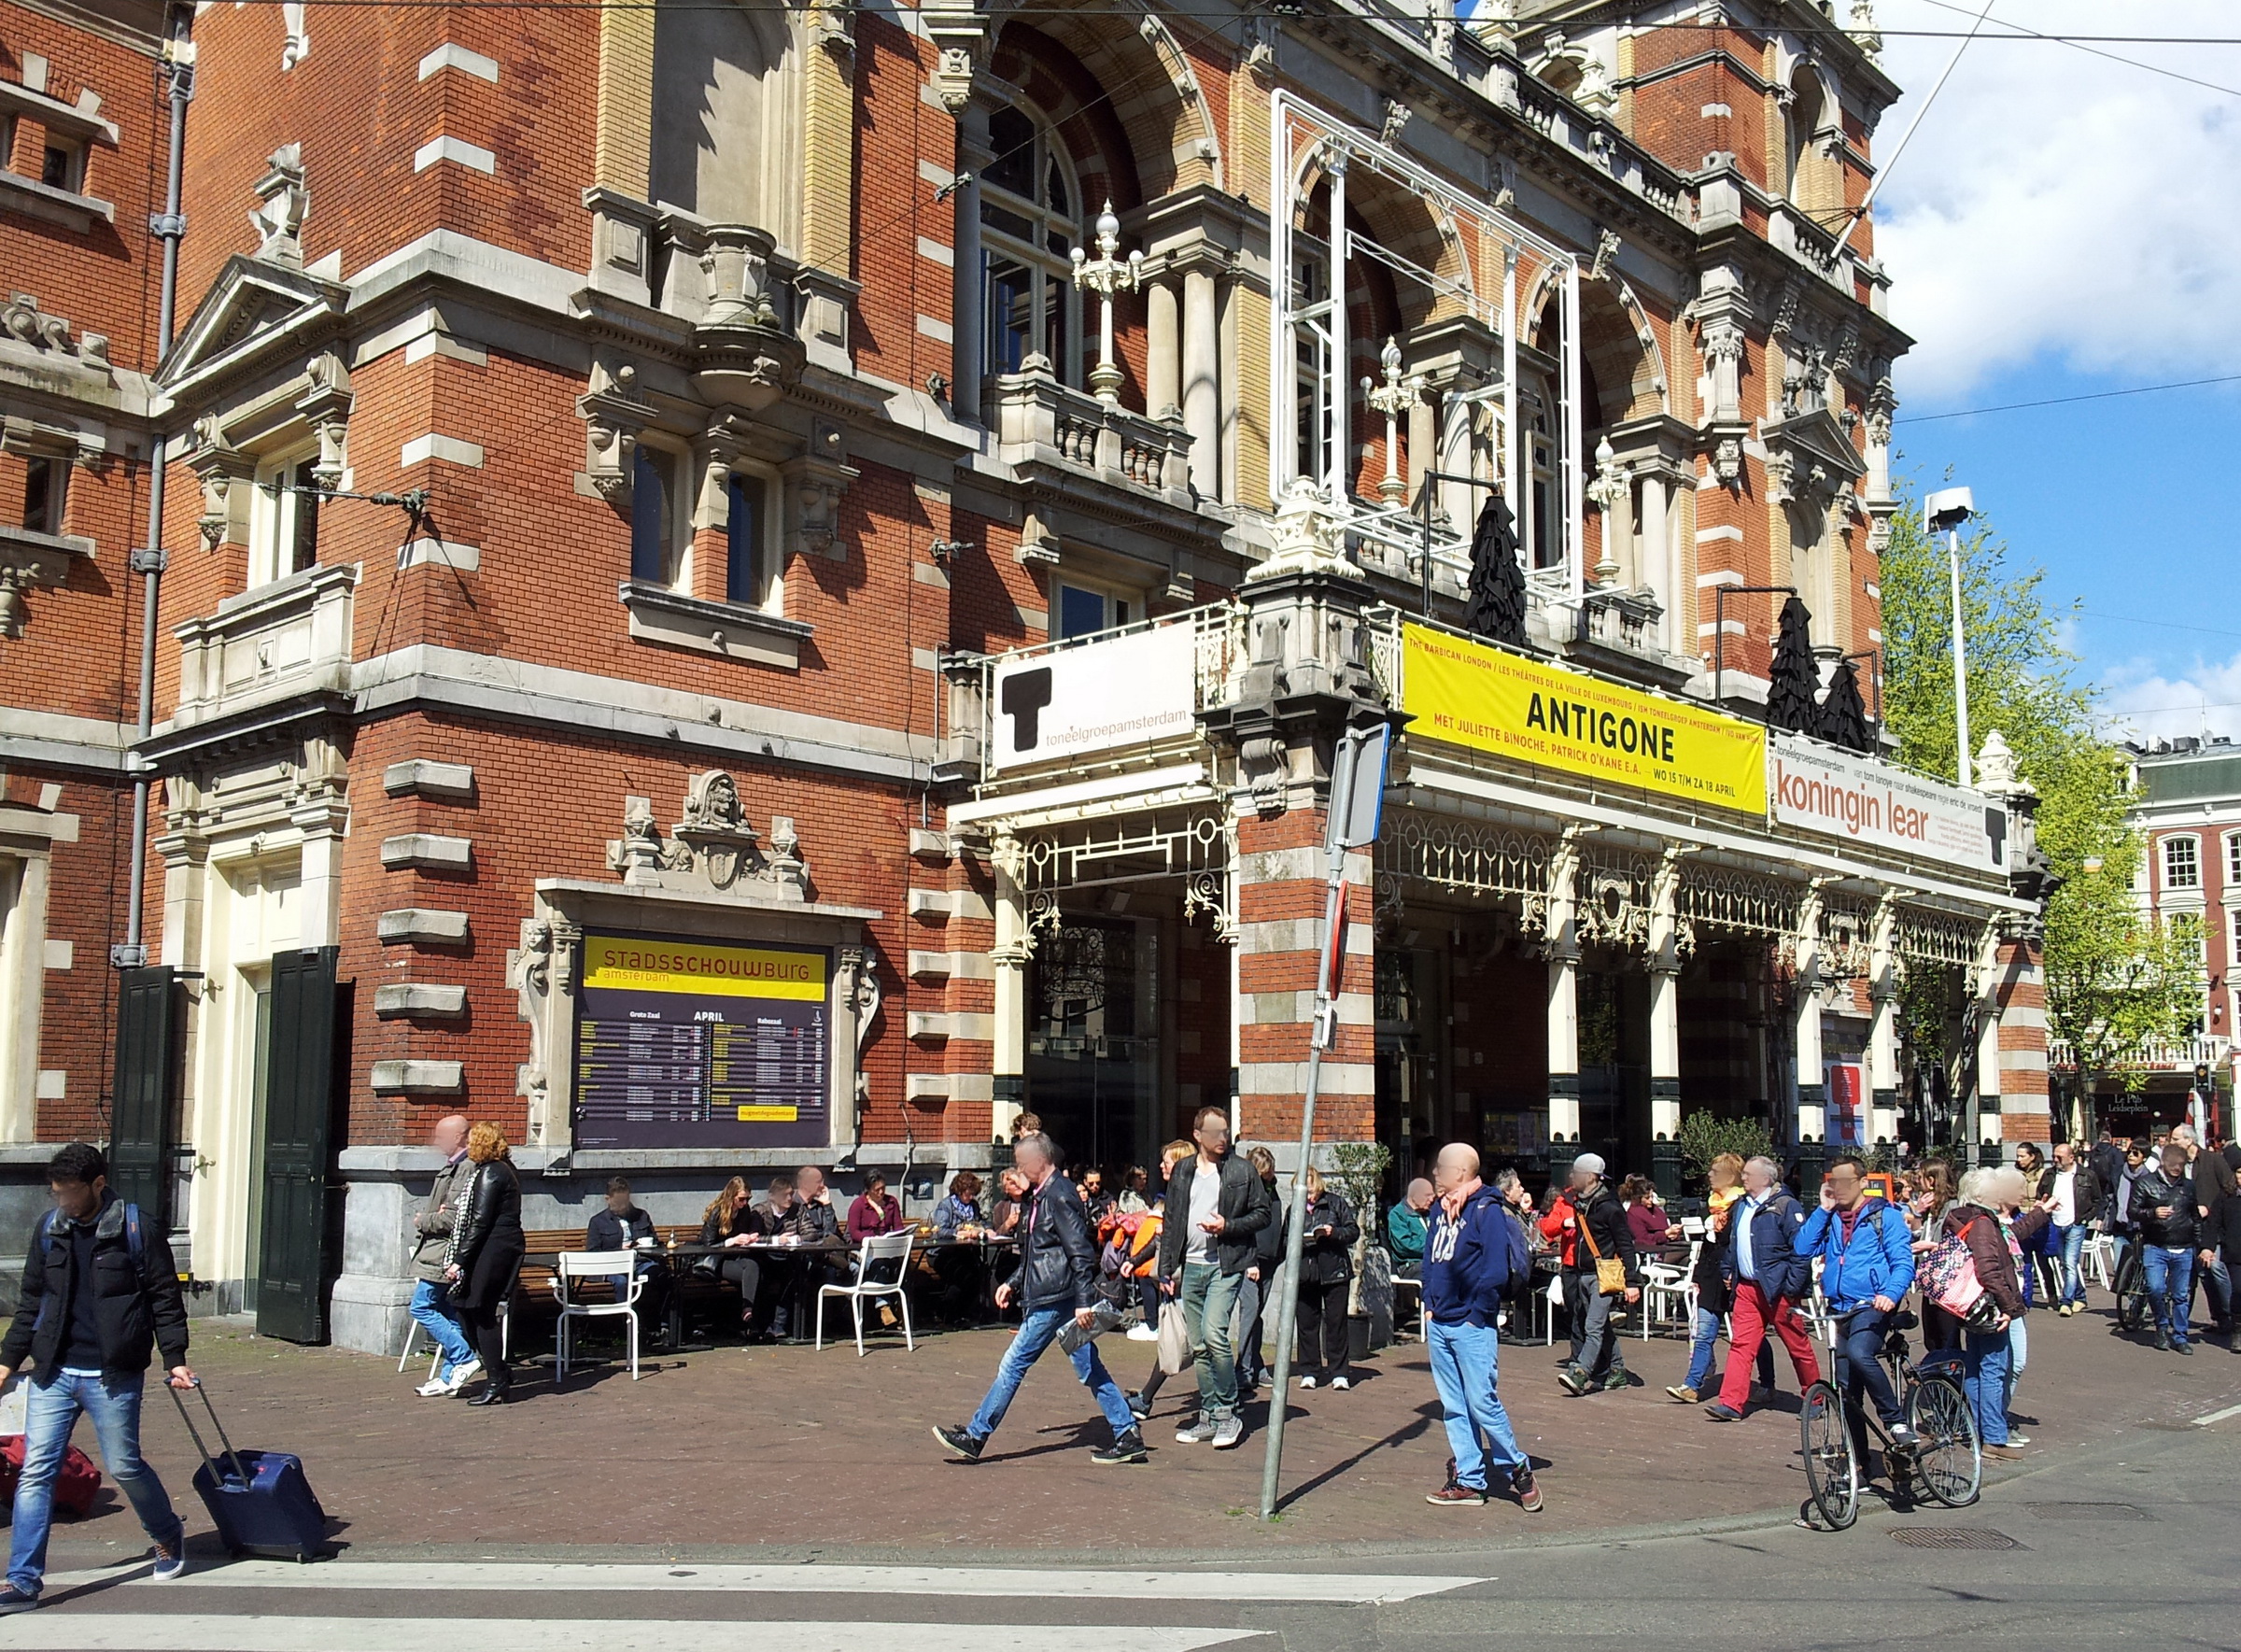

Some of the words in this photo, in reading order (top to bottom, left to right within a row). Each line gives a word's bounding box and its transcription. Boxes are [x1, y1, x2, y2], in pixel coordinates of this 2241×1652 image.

[1409, 638, 1423, 649] THE
[1424, 643, 1461, 661] BARBICAN
[1463, 655, 1492, 671] LONDON
[1499, 664, 1510, 676] LES
[1512, 668, 1544, 685] THÉÂTRES
[1545, 679, 1554, 689] DE
[1556, 682, 1564, 691] LA
[1565, 685, 1581, 697] VILLE
[1583, 690, 1591, 699] DE
[1593, 692, 1633, 710] LUXEMBOURG
[1638, 704, 1648, 713] ISM
[1648, 708, 1688, 725] TONEELGROEP
[1689, 719, 1721, 735] AMSTERDAM
[1046, 710, 1187, 747] toneelgroepamsterdam
[1526, 692, 1674, 763] ANTIGONE
[1434, 713, 1454, 729] MET
[1457, 719, 1501, 741] JULIETTE
[1503, 731, 1548, 755] BINOCHE,
[1551, 743, 1587, 763] PATRICK
[1590, 753, 1623, 771] O'KANE
[1625, 765, 1642, 775] E.A.
[1653, 768, 1667, 781] WO
[1669, 771, 1676, 784] 15
[1679, 774, 1692, 788] T/M
[1694, 778, 1704, 790] ZA
[1705, 781, 1713, 792] 18
[1715, 783, 1736, 798] APRIL
[1777, 743, 1845, 773] toneelgroepamsterdam
[1864, 770, 1874, 782] tom
[1875, 773, 1893, 788] lanoye
[1905, 783, 1937, 801] shakespeare
[1777, 758, 1881, 835] koningin
[1887, 791, 1929, 841] lear
[629, 1010, 646, 1019] Grote
[647, 1011, 661, 1020] Zaal
[694, 1010, 725, 1022] APRIL
[2107, 1104, 2149, 1115] Leidseplein
[2114, 1094, 2125, 1104] Le
[2126, 1094, 2143, 1105] Pub
